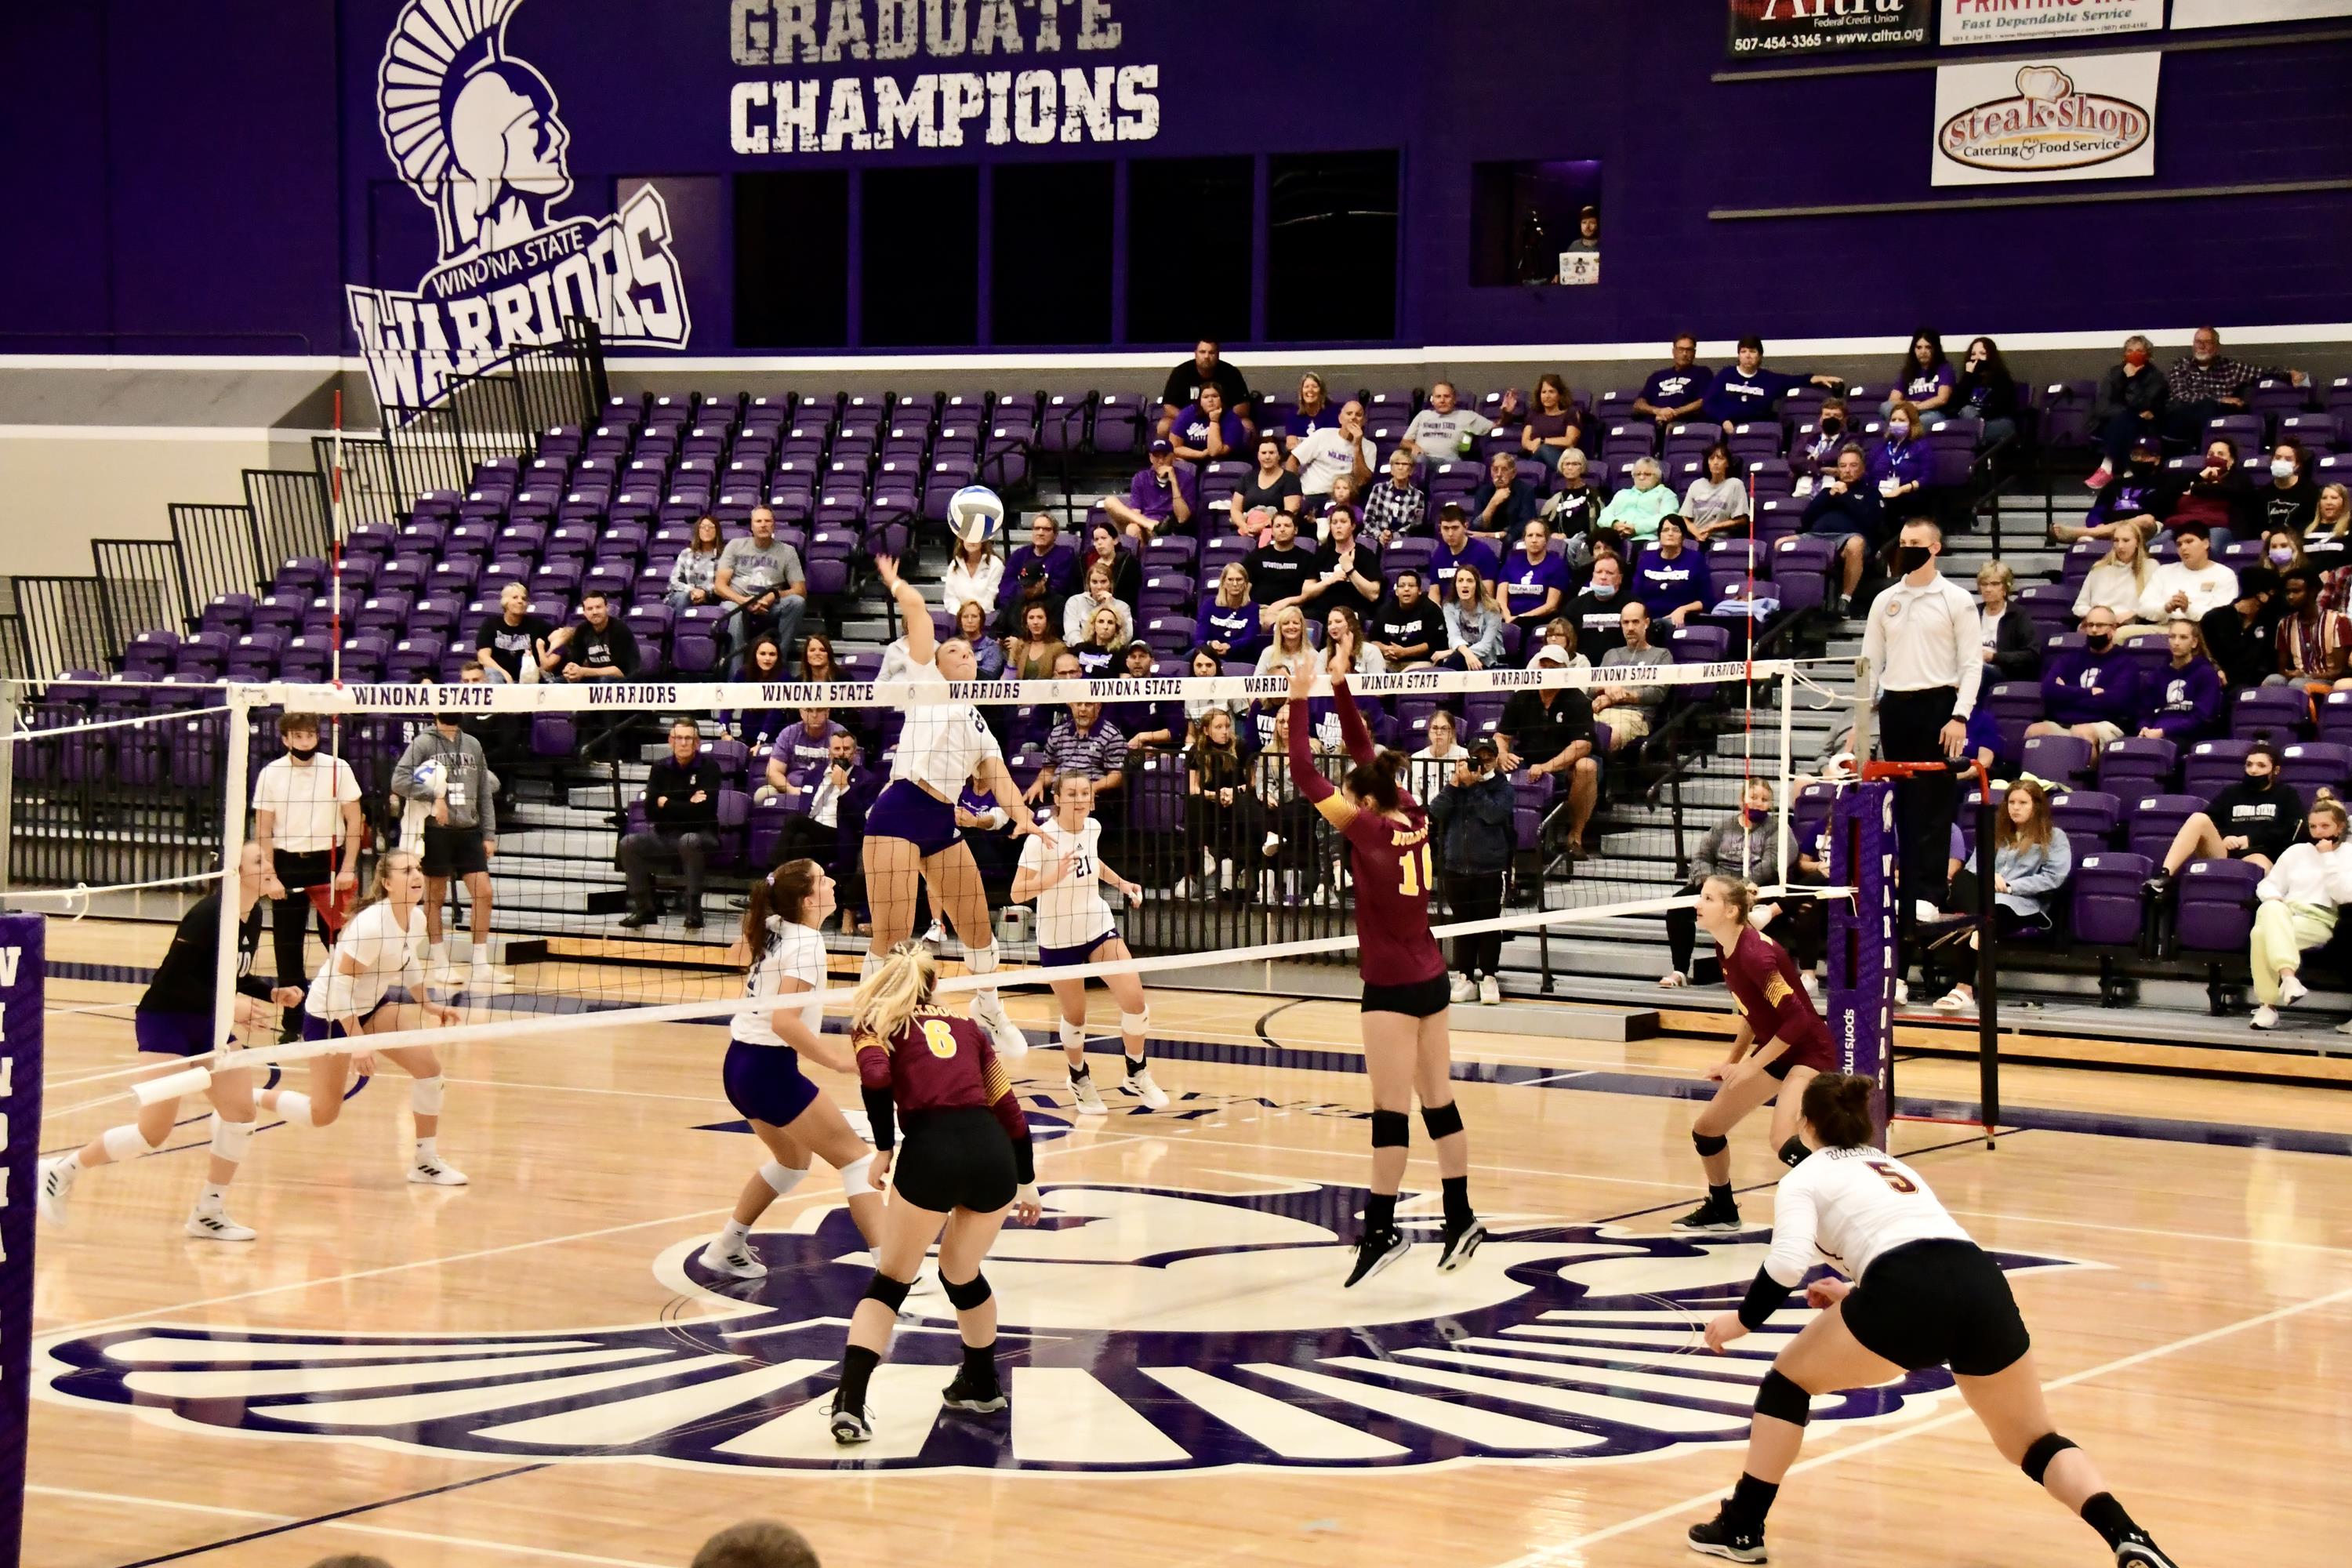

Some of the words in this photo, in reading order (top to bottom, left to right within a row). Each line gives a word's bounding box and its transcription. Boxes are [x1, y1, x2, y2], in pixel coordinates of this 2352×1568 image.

[1814, 17, 1843, 27] Federal
[1846, 16, 1871, 26] Credit
[1874, 14, 1899, 24] Union
[1962, 20, 1991, 30] Fast
[1996, 12, 2078, 28] Dependable
[2082, 8, 2132, 22] Service
[731, 0, 1122, 66] GRADUATE
[1734, 34, 1821, 51] 507-454-3365
[1835, 27, 1924, 45] www.altra.org
[731, 64, 1160, 154] CHAMPIONS
[1949, 97, 2048, 149] steak
[2057, 93, 2140, 141] shop
[1963, 144, 2019, 157] Catering
[2040, 140, 2071, 153] Food
[2073, 139, 2121, 151] Service
[432, 252, 523, 298] WINONA
[524, 224, 586, 267] STATE
[353, 193, 684, 409] WARRIORS
[1492, 670, 1542, 687] WARRIORS
[1591, 668, 1627, 682] WINONA
[1630, 667, 1658, 681] STATE
[1703, 662, 1745, 677] WARRIORS
[949, 682, 1020, 699] WARRIORS
[1090, 680, 1139, 696] WINONA
[1145, 679, 1181, 695] STATE
[1244, 677, 1289, 693] WARRIO
[1361, 674, 1403, 690] WINONA
[1406, 673, 1439, 688] STATE
[352, 686, 430, 706] WINONA
[438, 687, 493, 706] STATE
[589, 685, 677, 704] WARRIORS
[761, 684, 822, 702] WINONA
[829, 684, 874, 702] STATE
[1076, 855, 1092, 878] 21
[924, 1019, 957, 1059] 6
[1843, 1008, 1857, 1050] sports
[1863, 1160, 1920, 1195] 5
